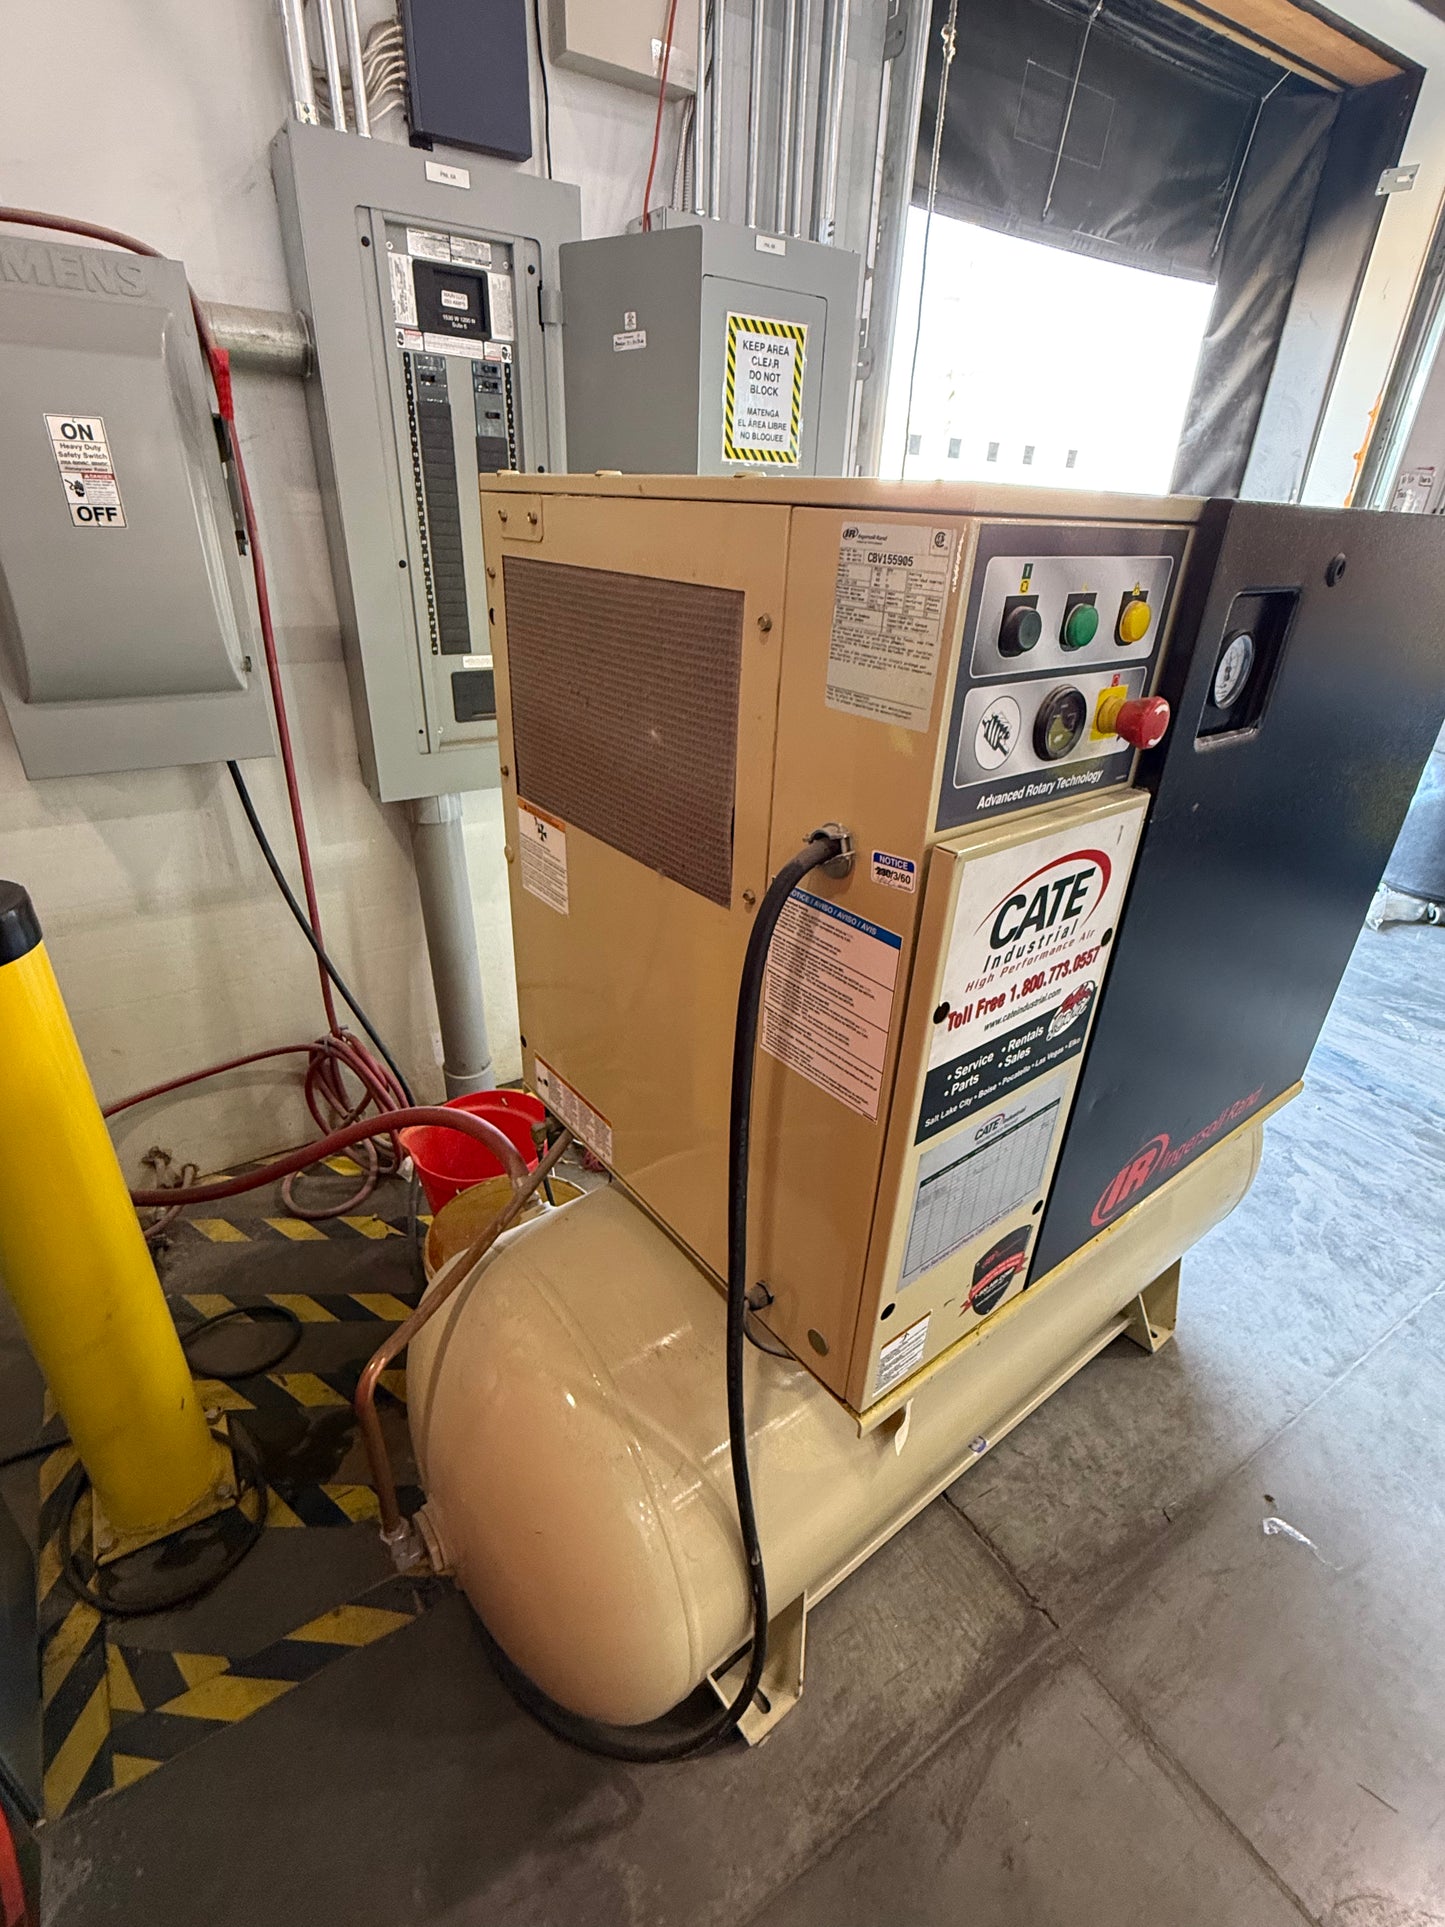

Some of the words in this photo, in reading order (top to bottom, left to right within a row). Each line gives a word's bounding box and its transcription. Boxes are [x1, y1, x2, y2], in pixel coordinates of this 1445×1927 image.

[742, 339, 765, 351] KEEP
[766, 344, 790, 356] AREA
[751, 355, 780, 369] CLEAR
[749, 370, 761, 381] DO
[763, 371, 781, 383] NOT
[750, 384, 779, 397] BLOCK
[746, 407, 780, 418] MATENGA
[61, 423, 94, 441] ON
[738, 419, 746, 427] EL
[767, 420, 787, 431] LIBRE
[60, 443, 83, 451] Heavy
[740, 431, 750, 440] NO
[751, 432, 784, 443] BLOQUEE
[58, 452, 81, 460] Safety
[83, 452, 108, 460] Switch
[77, 506, 118, 522] OFF
[867, 551, 914, 567] CBV155905
[976, 786, 1026, 810] Advanced
[1025, 781, 1055, 797] Rotary
[1056, 770, 1104, 790] Technology
[880, 854, 909, 870] NOTICE
[790, 889, 809, 903] OTICE
[814, 901, 833, 914] AVISO
[837, 912, 857, 925] AVISO
[861, 923, 877, 935] AVIS
[989, 866, 1097, 950] CATE
[982, 918, 1079, 974] Industrial
[964, 973, 995, 993] High
[1000, 937, 1075, 978] Performance
[1079, 928, 1096, 943] Air
[947, 1003, 973, 1031] Toll
[975, 992, 1006, 1019] Free
[1010, 944, 1102, 1000] 1.800.773.0557
[983, 988, 1063, 1031] www.cateindustrial.com
[1007, 1025, 1044, 1052] Rentals
[954, 1051, 994, 1080] Service
[1004, 1045, 1032, 1067] Sales
[924, 1114, 940, 1128] Salt
[940, 1105, 958, 1119] Lake
[958, 1095, 974, 1109] City
[978, 1084, 997, 1099] Boise
[1034, 1056, 1046, 1067] Las
[1046, 1045, 1065, 1060] Vegas
[950, 1073, 980, 1096] Parts
[974, 1119, 1000, 1141] CATE
[1100, 1147, 1159, 1216] IR
